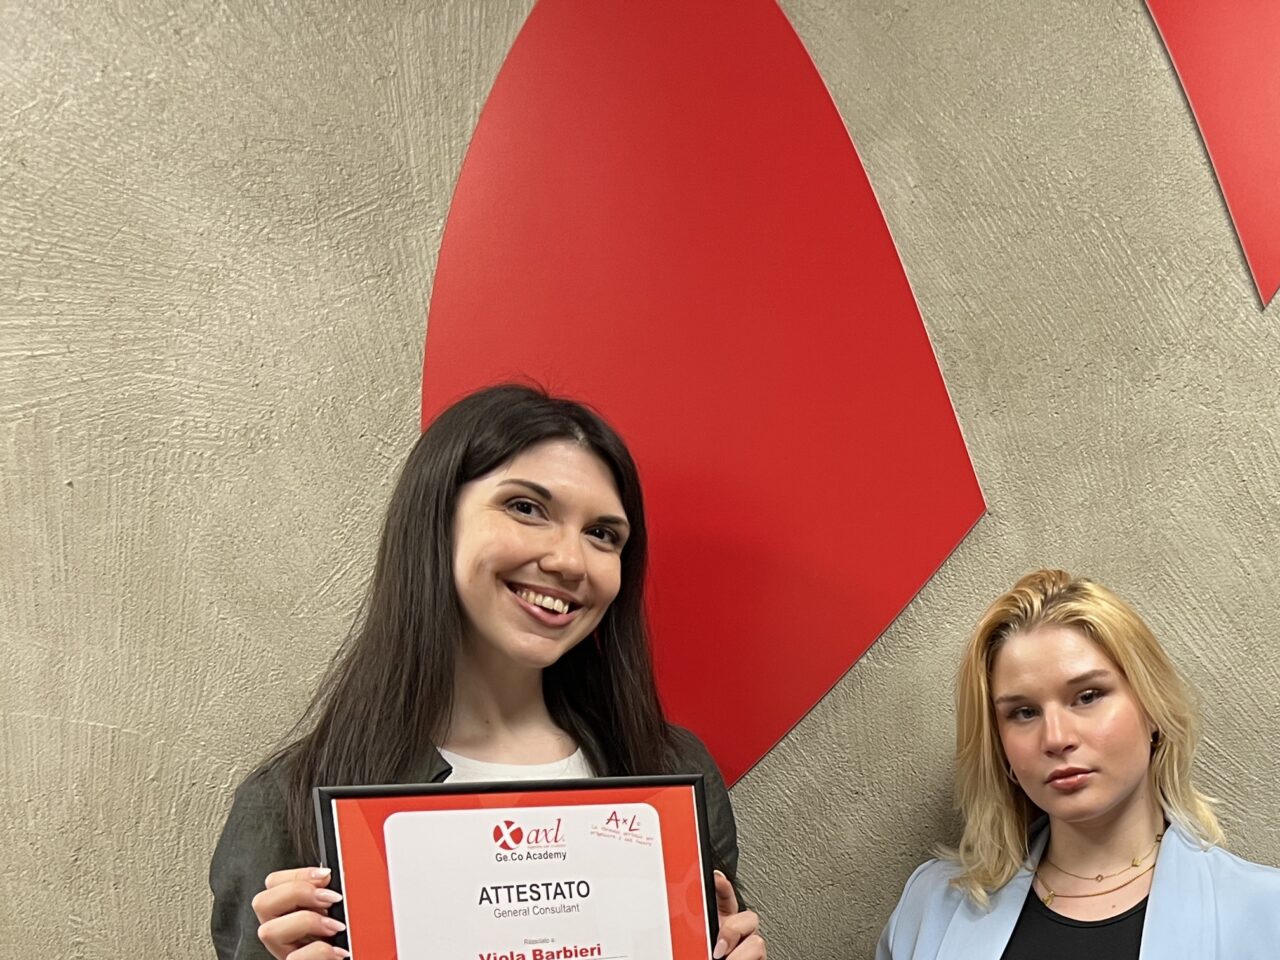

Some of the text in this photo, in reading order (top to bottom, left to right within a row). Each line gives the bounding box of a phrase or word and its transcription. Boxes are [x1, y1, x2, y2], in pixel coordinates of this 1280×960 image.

[526, 852, 567, 862] Academy
[478, 880, 590, 905] ATTESTATO
[494, 904, 580, 918] General Consultant
[532, 944, 602, 960] Barbieri
